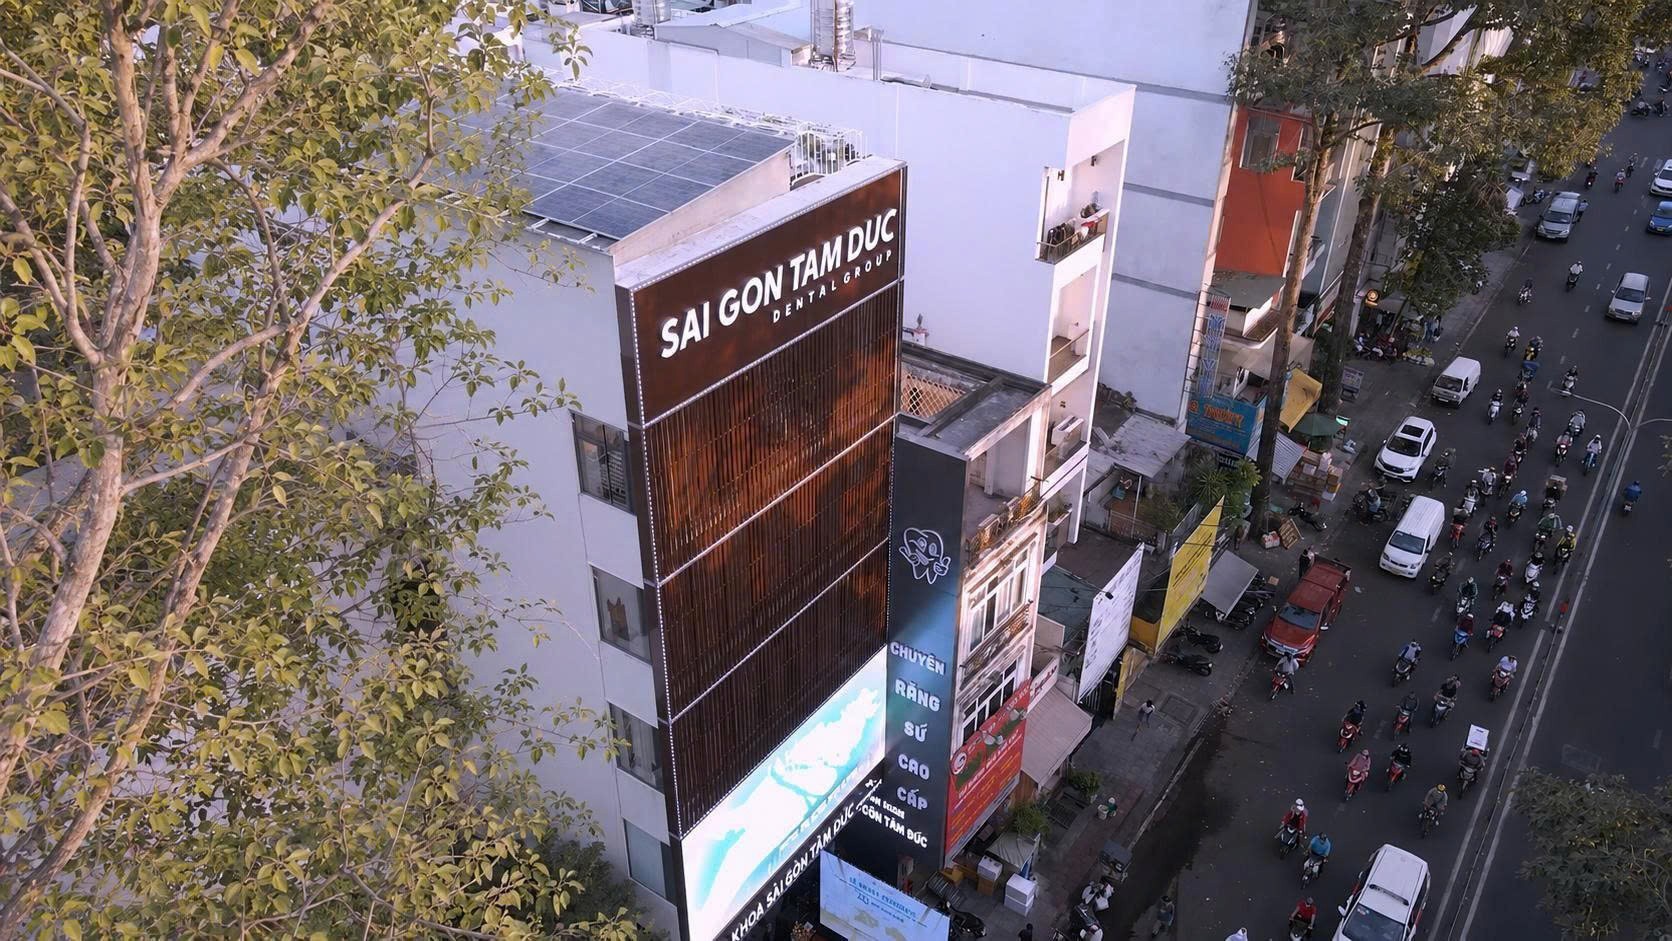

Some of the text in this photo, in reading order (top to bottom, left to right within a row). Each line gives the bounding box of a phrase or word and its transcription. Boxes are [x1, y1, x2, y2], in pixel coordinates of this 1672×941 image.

[661, 208, 898, 359] SAI GON TAM DUC
[772, 249, 893, 324] DENTAL GROUP
[890, 641, 946, 676] CHUYÊN
[895, 679, 941, 712] RĂNG
[904, 721, 928, 742] SỨ
[898, 753, 930, 780] CAO
[731, 902, 764, 941] KHOA
